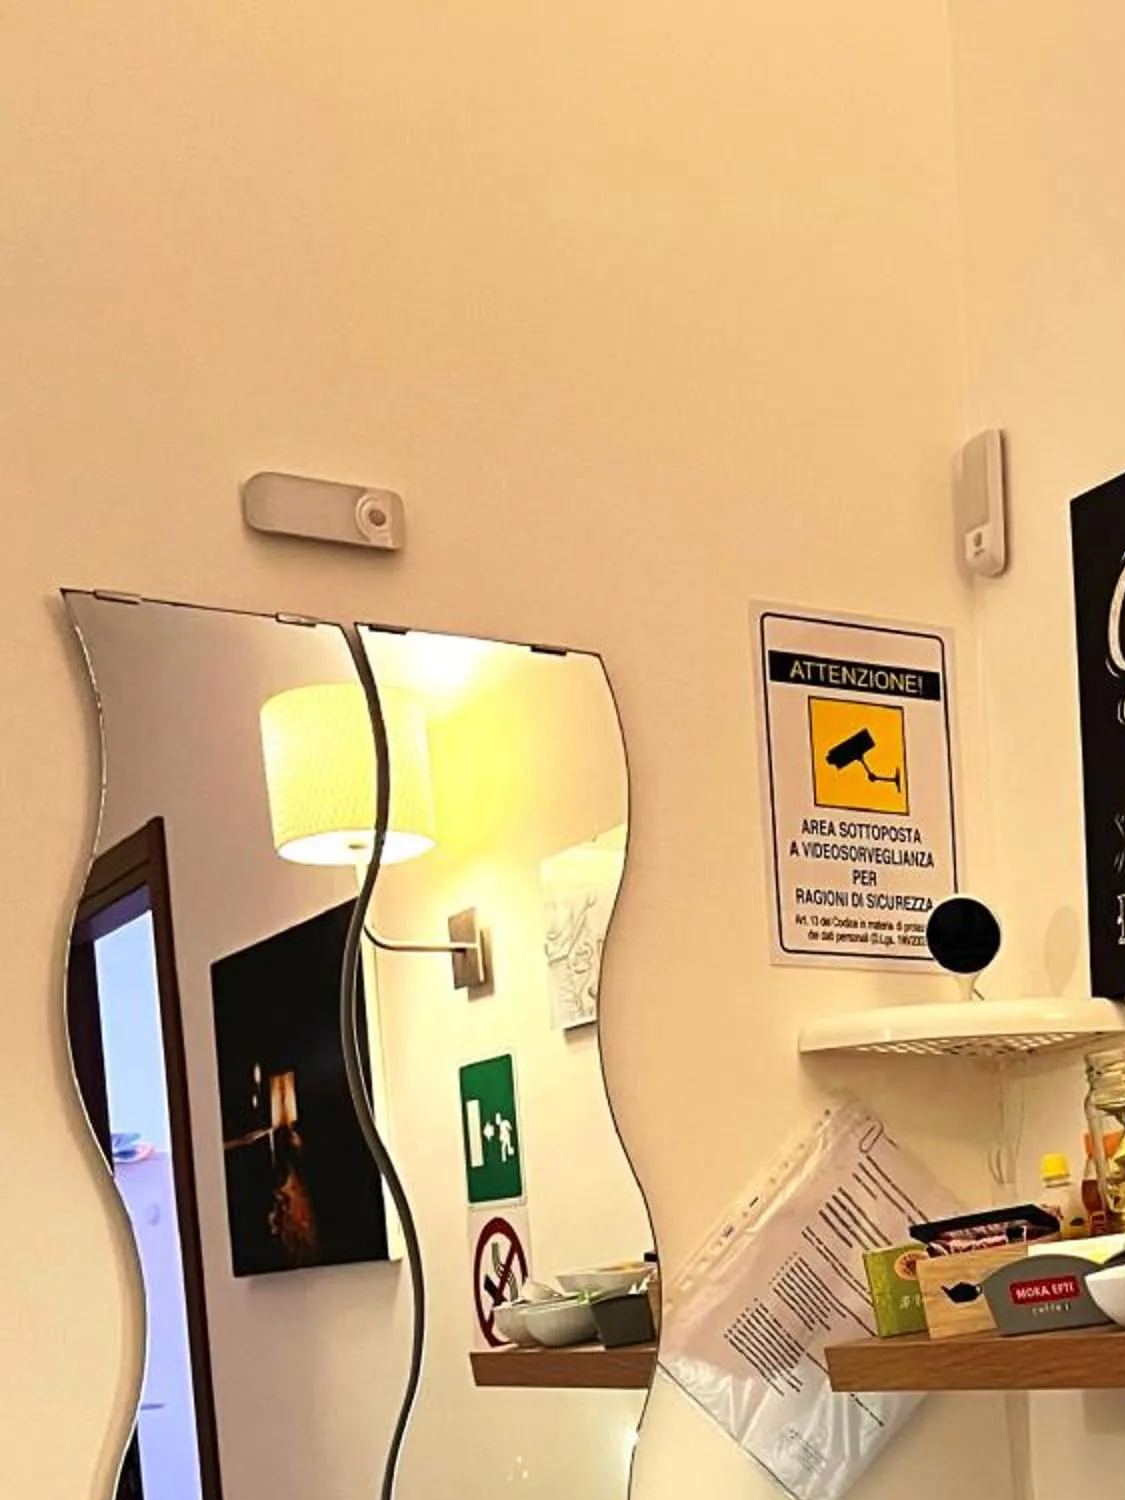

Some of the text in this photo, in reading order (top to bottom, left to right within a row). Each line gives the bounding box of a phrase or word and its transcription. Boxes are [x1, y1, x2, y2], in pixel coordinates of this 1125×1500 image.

[789, 660, 923, 694] ATTENZIONE!
[801, 818, 922, 844] AREA SOTTOPOSTA
[789, 841, 935, 867] A VIDEOSORVEGLIANZA
[852, 869, 877, 887] PER
[795, 887, 934, 912] RAGIONI DI SICUREZZA
[1015, 1285, 1051, 1299] MOKA
